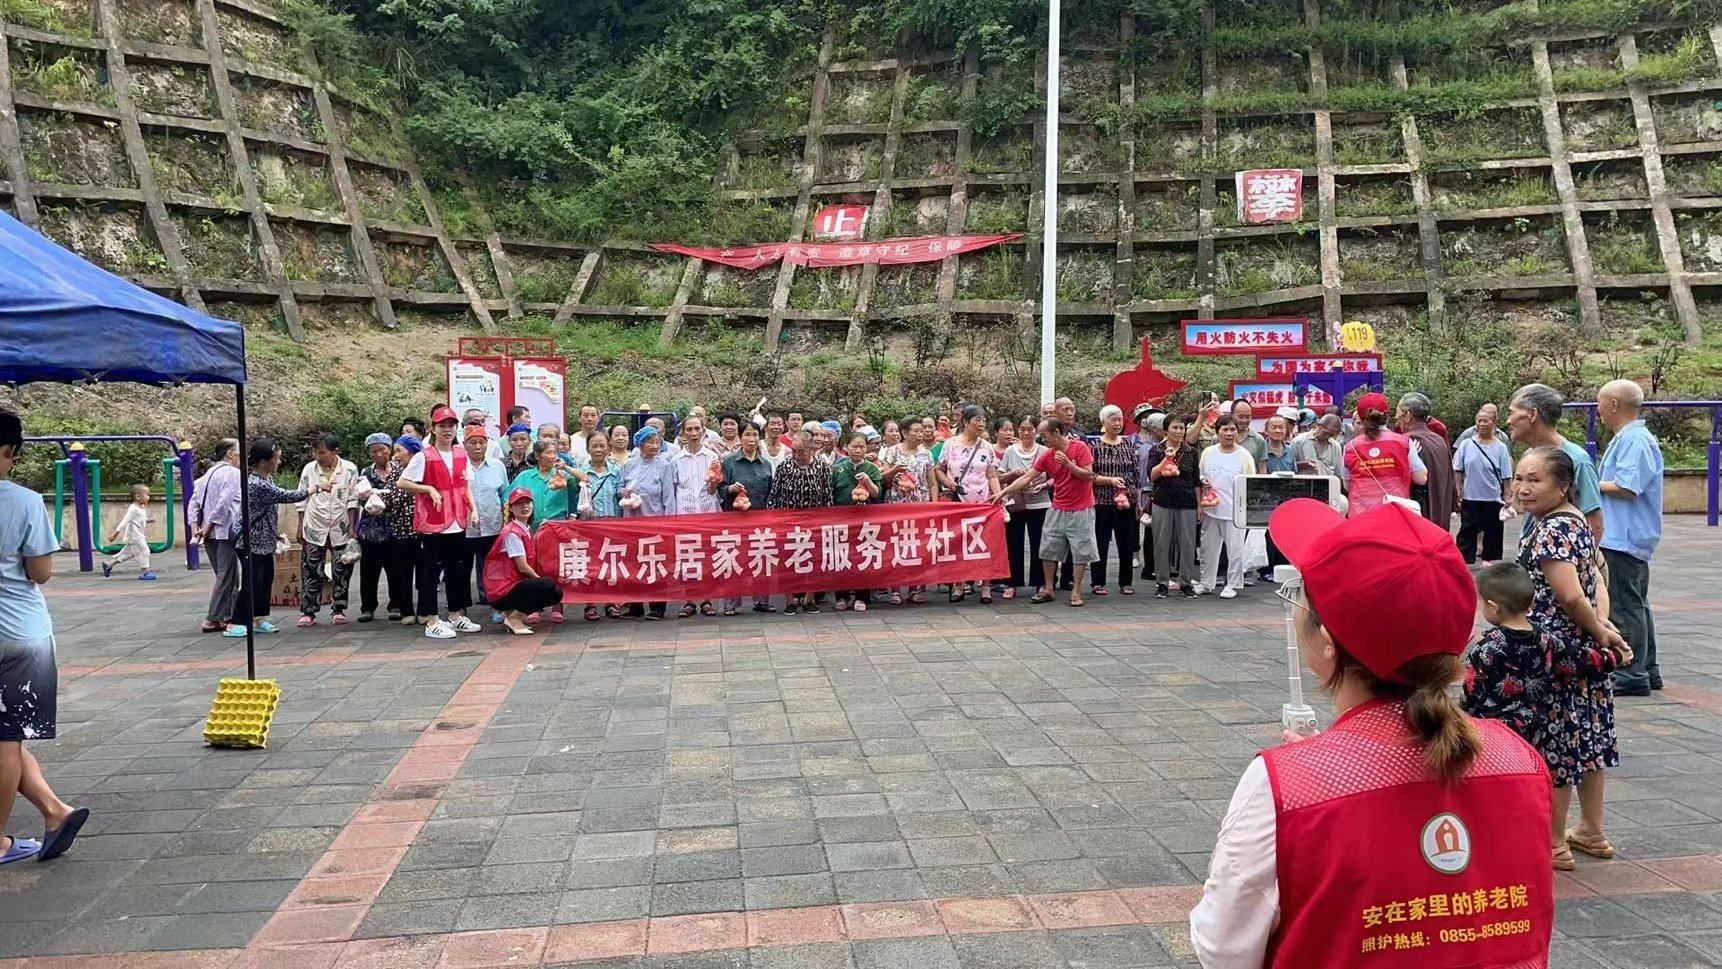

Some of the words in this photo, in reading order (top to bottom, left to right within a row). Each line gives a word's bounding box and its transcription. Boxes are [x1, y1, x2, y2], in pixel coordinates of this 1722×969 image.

[1247, 174, 1297, 218] 攀
[817, 208, 857, 237] 止
[1195, 331, 1293, 345] 用火防火不失火
[1351, 326, 1368, 340] 119
[1288, 391, 1331, 404] 防于未燃
[558, 515, 992, 587] 康尔乐居家养老服务进社区
[1362, 884, 1528, 929] 安在家里的养老院
[1439, 919, 1531, 943] 0855-8589599
